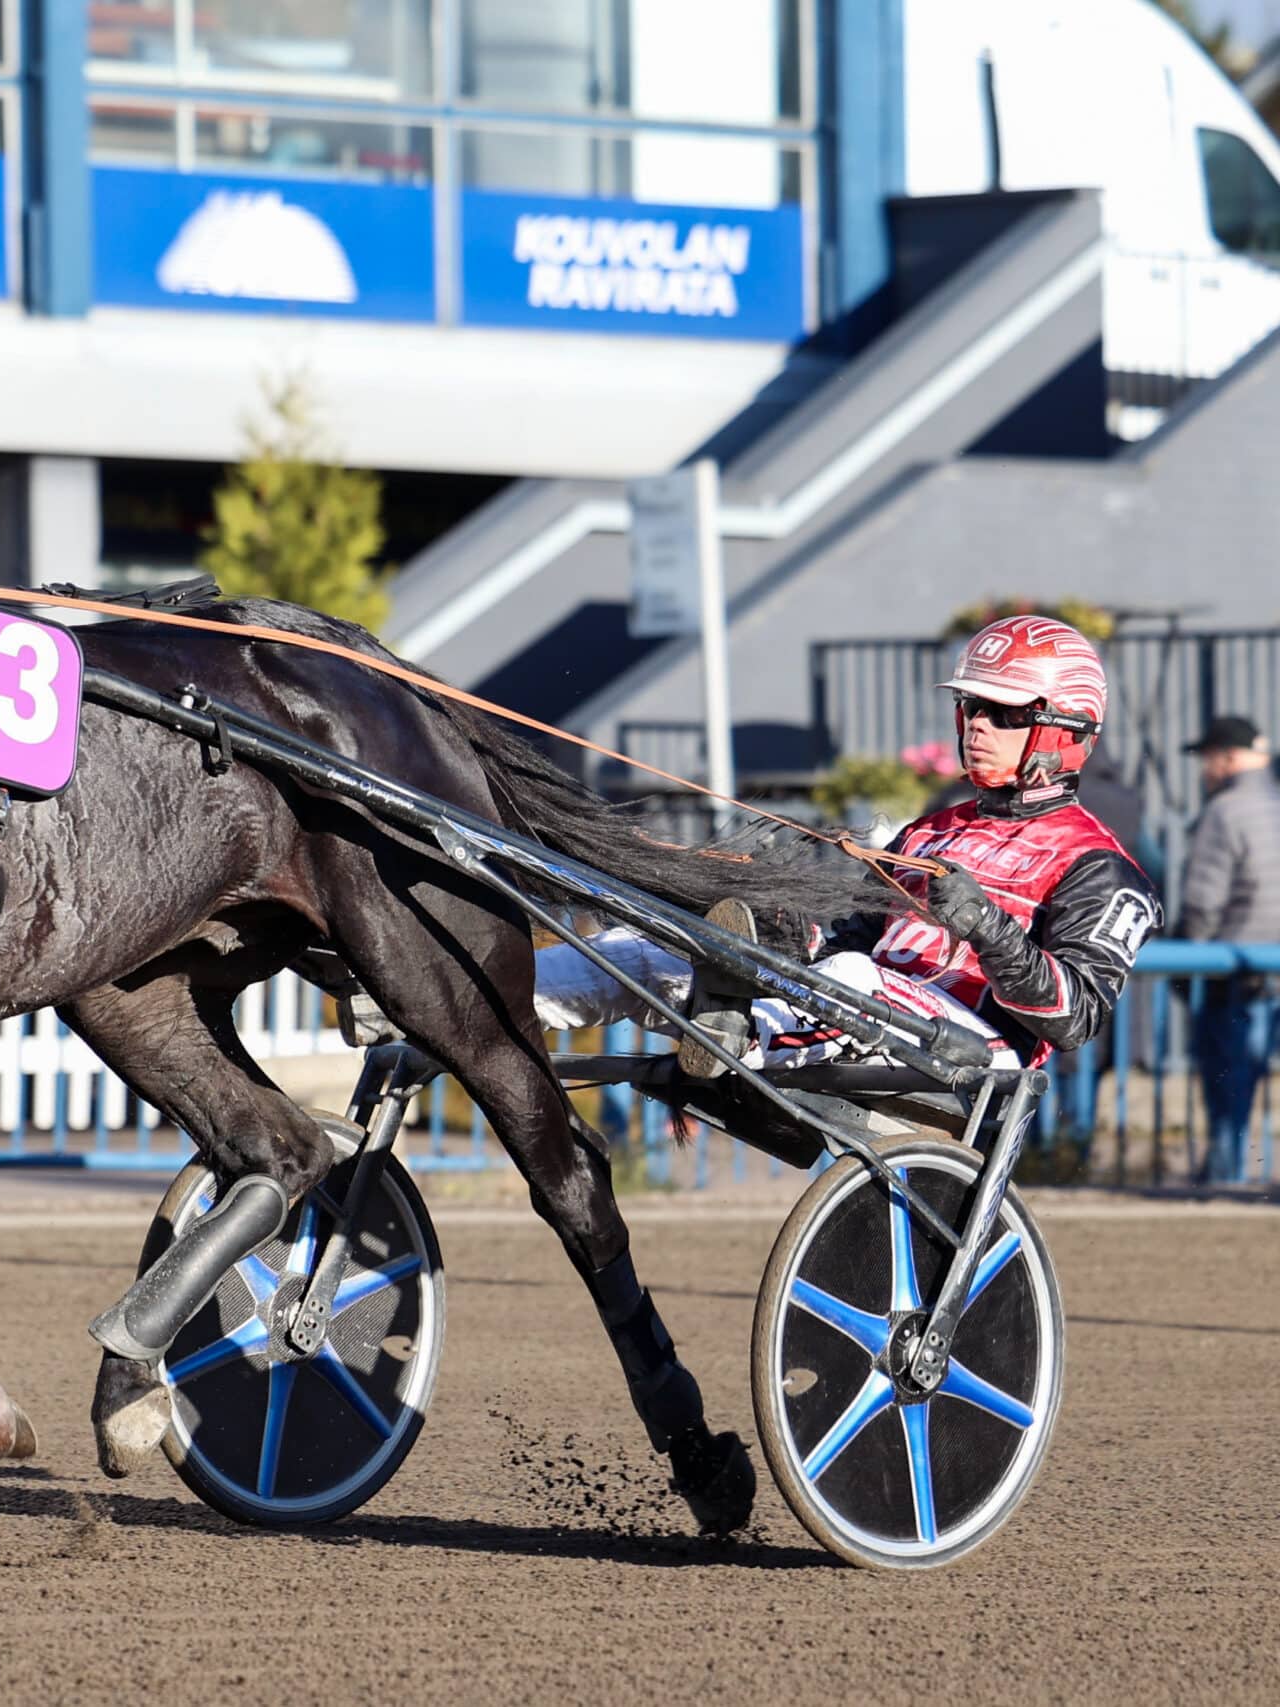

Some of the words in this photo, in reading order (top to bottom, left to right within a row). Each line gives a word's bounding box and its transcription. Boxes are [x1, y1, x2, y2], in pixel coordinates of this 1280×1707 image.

[514, 214, 749, 273] KOUVOLAN
[528, 264, 738, 317] RAVIRATA
[977, 637, 1005, 657] H
[1109, 902, 1149, 953] H
